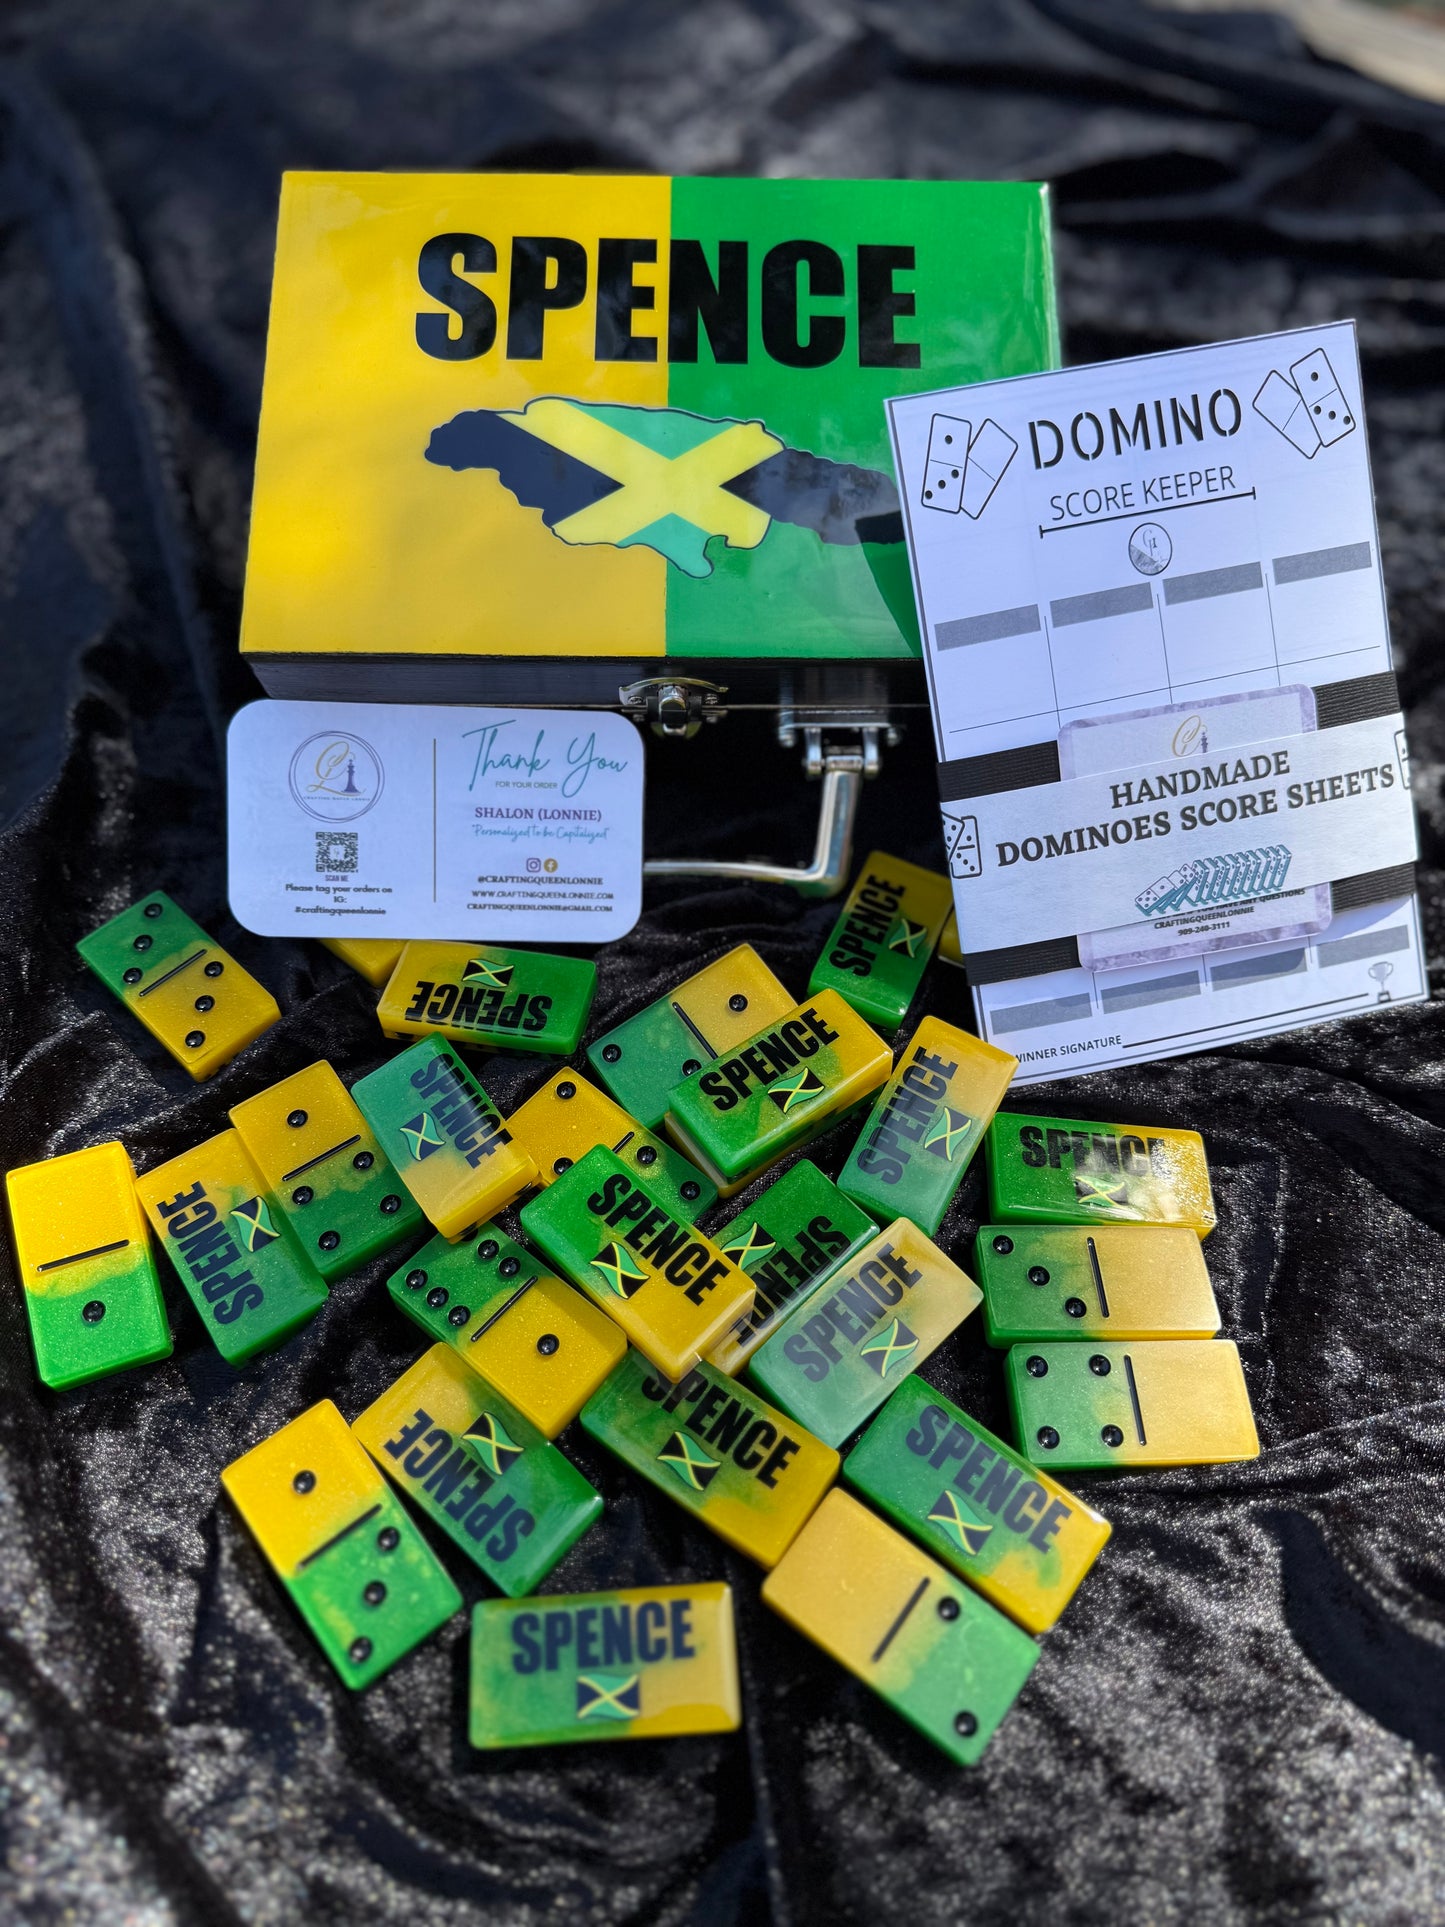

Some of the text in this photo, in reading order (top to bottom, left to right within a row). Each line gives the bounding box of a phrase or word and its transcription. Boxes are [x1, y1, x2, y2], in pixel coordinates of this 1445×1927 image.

[415, 233, 922, 369] SPENCE
[1029, 387, 1242, 470] DOMINO
[1049, 465, 1236, 522] SCORE KEEPER
[462, 719, 629, 798] Thank You
[512, 781, 532, 789] YOUR
[1110, 749, 1291, 810] HANDMADE
[474, 807, 602, 822] SHALON (LONNIE)
[531, 825, 541, 837] to
[542, 825, 554, 838] be
[997, 763, 1396, 867] DOMINOES SCORE SHEETS
[285, 883, 313, 892] Please
[315, 885, 330, 894] tag
[332, 886, 351, 894] your
[353, 884, 380, 893] orders
[295, 905, 387, 916] #craftingqueenlonnie
[466, 903, 613, 913] CRAFTINGQUEENLONNIE@GMAIL.COM
[471, 890, 614, 900] WWW.CRAFTINGQUEENLONNIE.COM
[477, 875, 604, 886] @CRAFTINGQUEENLONNIE
[1258, 888, 1306, 903] QUESTIONS
[829, 874, 906, 977] SPENCE
[1153, 905, 1255, 930] CRAFTINGQUEENLONNIE
[408, 979, 551, 1033] SPENCE
[698, 1007, 840, 1112] SPENCE
[1060, 1035, 1122, 1056] SIGNATURE
[409, 1052, 514, 1170] SPENCE
[858, 1045, 961, 1186] SPENCE
[156, 1181, 264, 1326] SPENCE
[587, 1172, 731, 1306] SPENCE
[785, 1243, 923, 1385] SPENCE
[384, 1407, 536, 1566] SPENCE
[905, 1404, 1075, 1555] SPENCE
[510, 1598, 696, 1676] SPENCE
